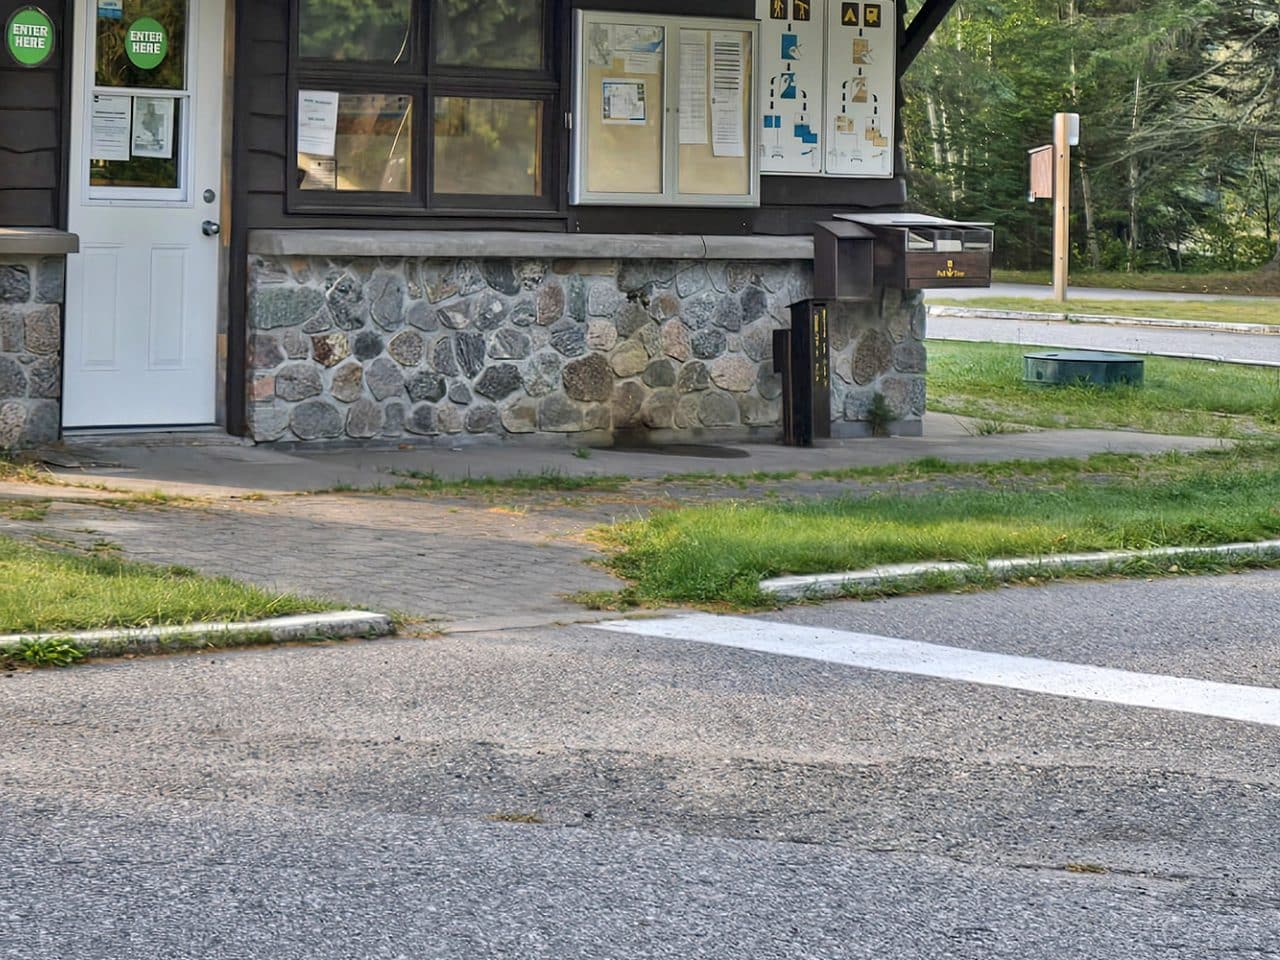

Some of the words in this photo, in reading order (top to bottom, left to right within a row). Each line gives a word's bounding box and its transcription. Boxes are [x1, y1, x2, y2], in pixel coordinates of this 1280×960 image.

[12, 23, 48, 37] ENTER
[130, 30, 163, 42] ENTER
[15, 36, 46, 49] HERE
[132, 42, 161, 54] HERE
